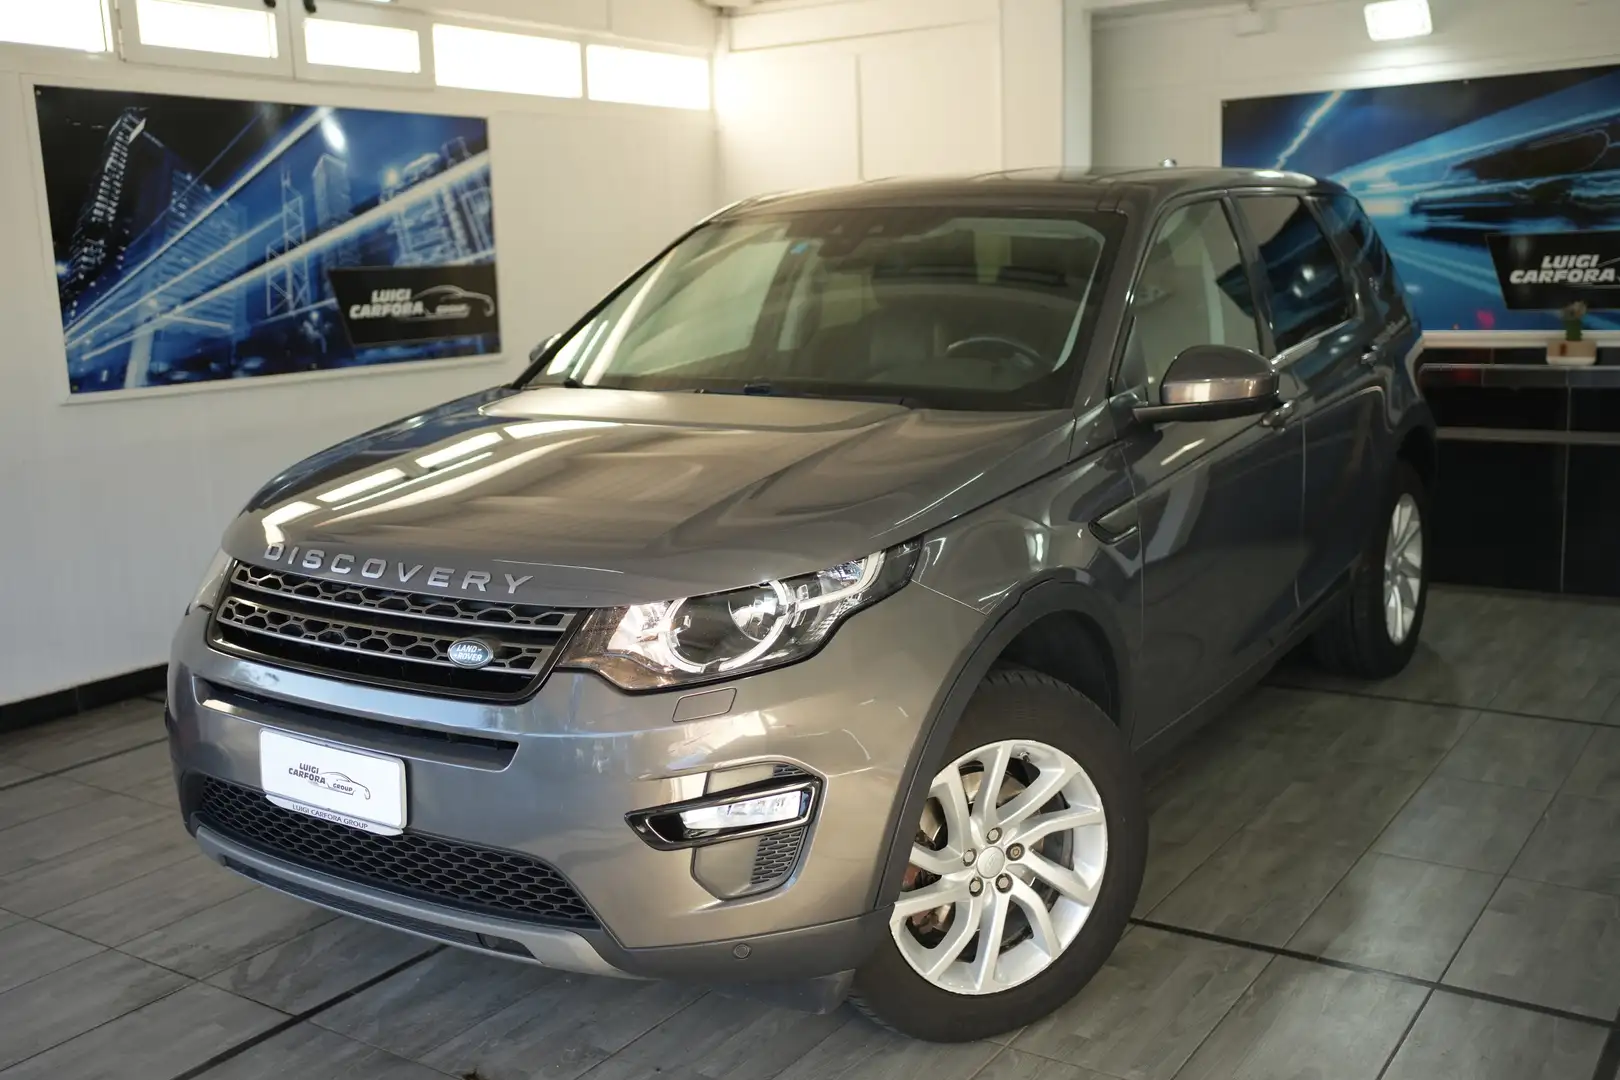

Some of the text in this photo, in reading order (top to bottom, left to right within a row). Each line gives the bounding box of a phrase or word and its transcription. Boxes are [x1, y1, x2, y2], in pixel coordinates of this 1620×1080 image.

[1541, 254, 1599, 268] LUIGI
[1509, 268, 1615, 284] CARFORA
[263, 543, 533, 594] DISCOVERY
[288, 767, 326, 784] CARFORA
[299, 762, 320, 774] LUIGI
[332, 782, 353, 793] GROUP
[292, 803, 368, 830] LUIGI CARFORA GROUP
